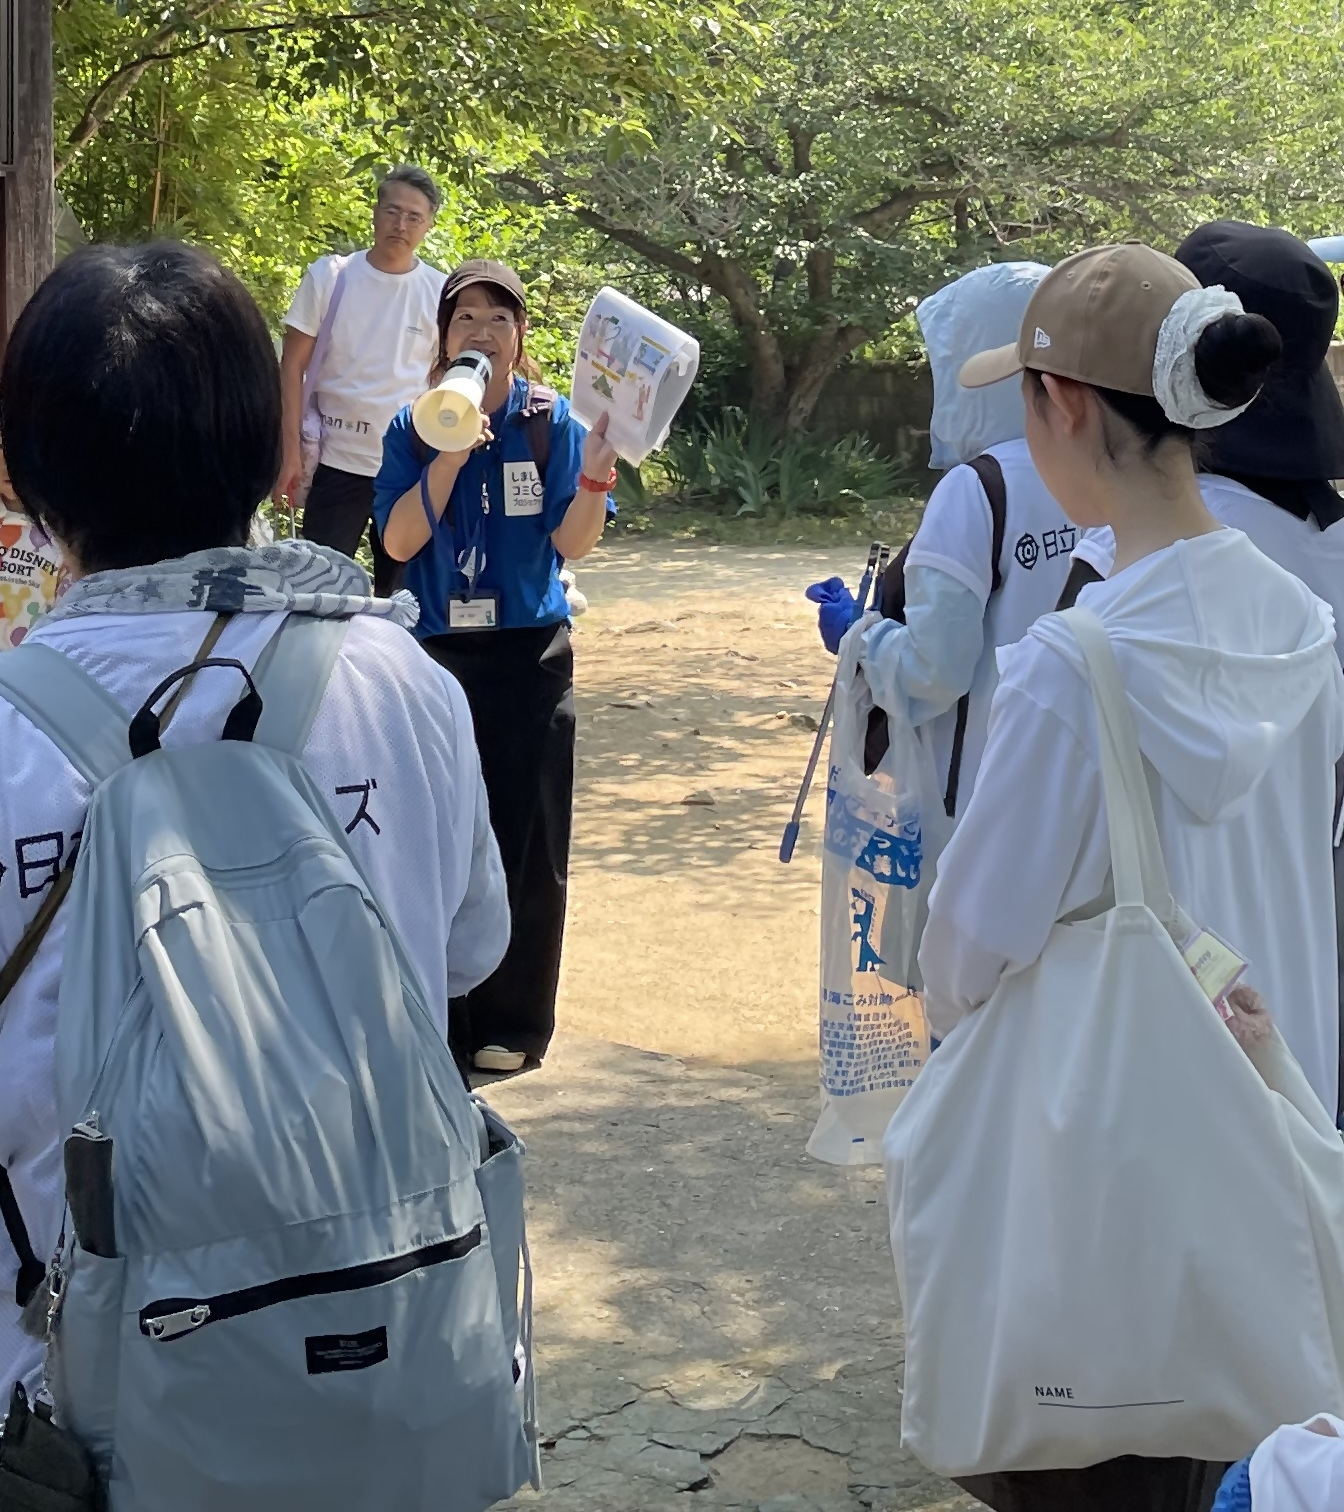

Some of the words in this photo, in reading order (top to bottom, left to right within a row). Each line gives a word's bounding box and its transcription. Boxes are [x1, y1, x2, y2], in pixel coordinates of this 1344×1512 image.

[1042, 524, 1076, 560] 日立
[10, 548, 59, 575] DISNEY
[1034, 1385, 1075, 1400] NAME
